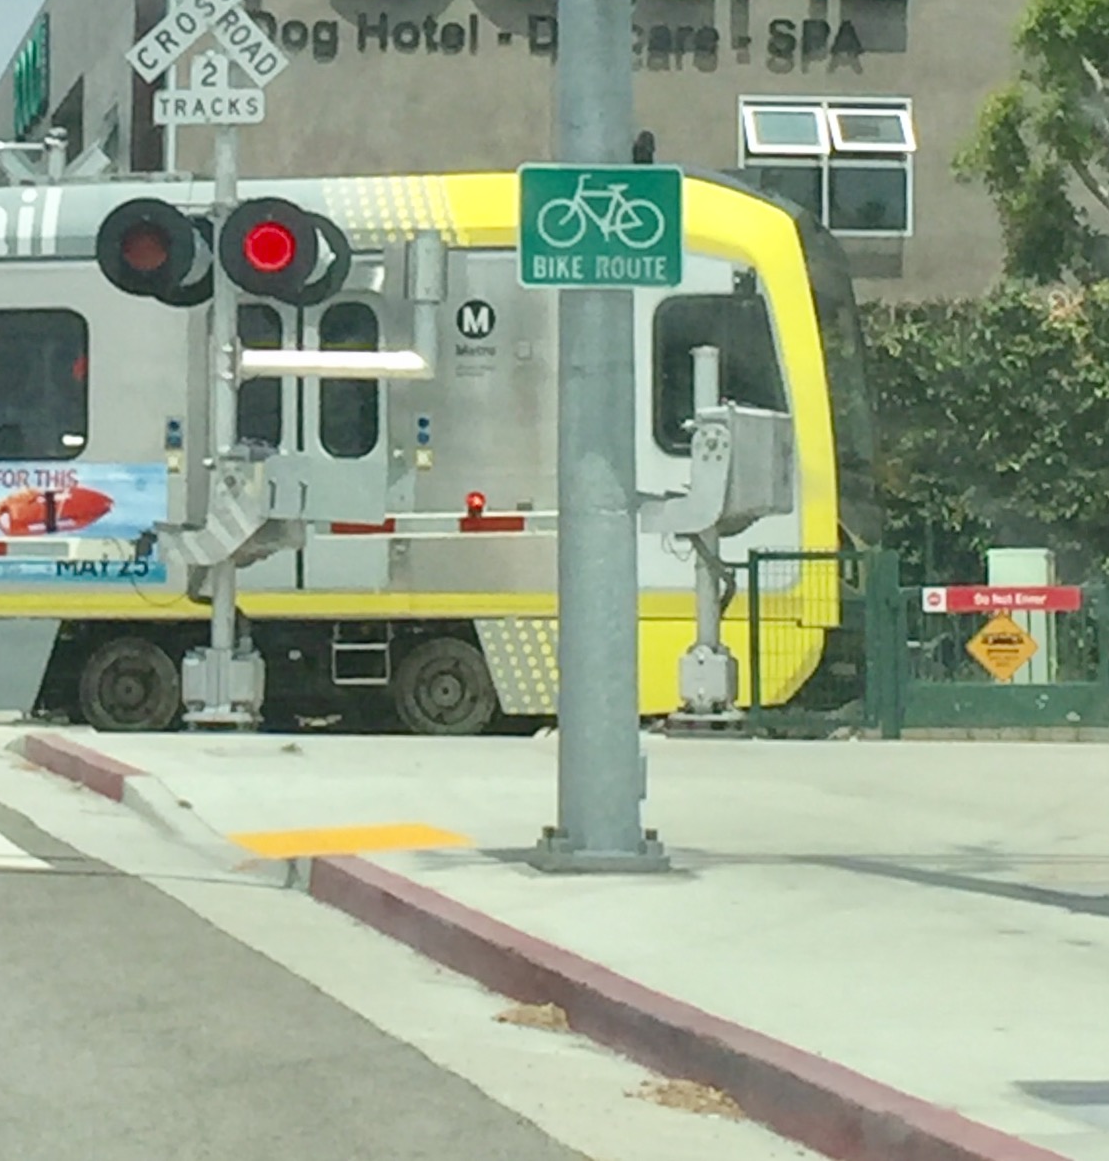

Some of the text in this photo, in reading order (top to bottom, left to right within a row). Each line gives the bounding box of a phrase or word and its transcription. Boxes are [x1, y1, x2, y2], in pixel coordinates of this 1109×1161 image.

[358, 13, 478, 52] Hotel
[768, 19, 863, 58] SPA
[201, 60, 217, 87] 2
[160, 97, 258, 115] TRACKS
[533, 255, 667, 281] BIKE ROUTE
[34, 469, 79, 489] THIS
[973, 592, 1047, 606] Do Not Enter
